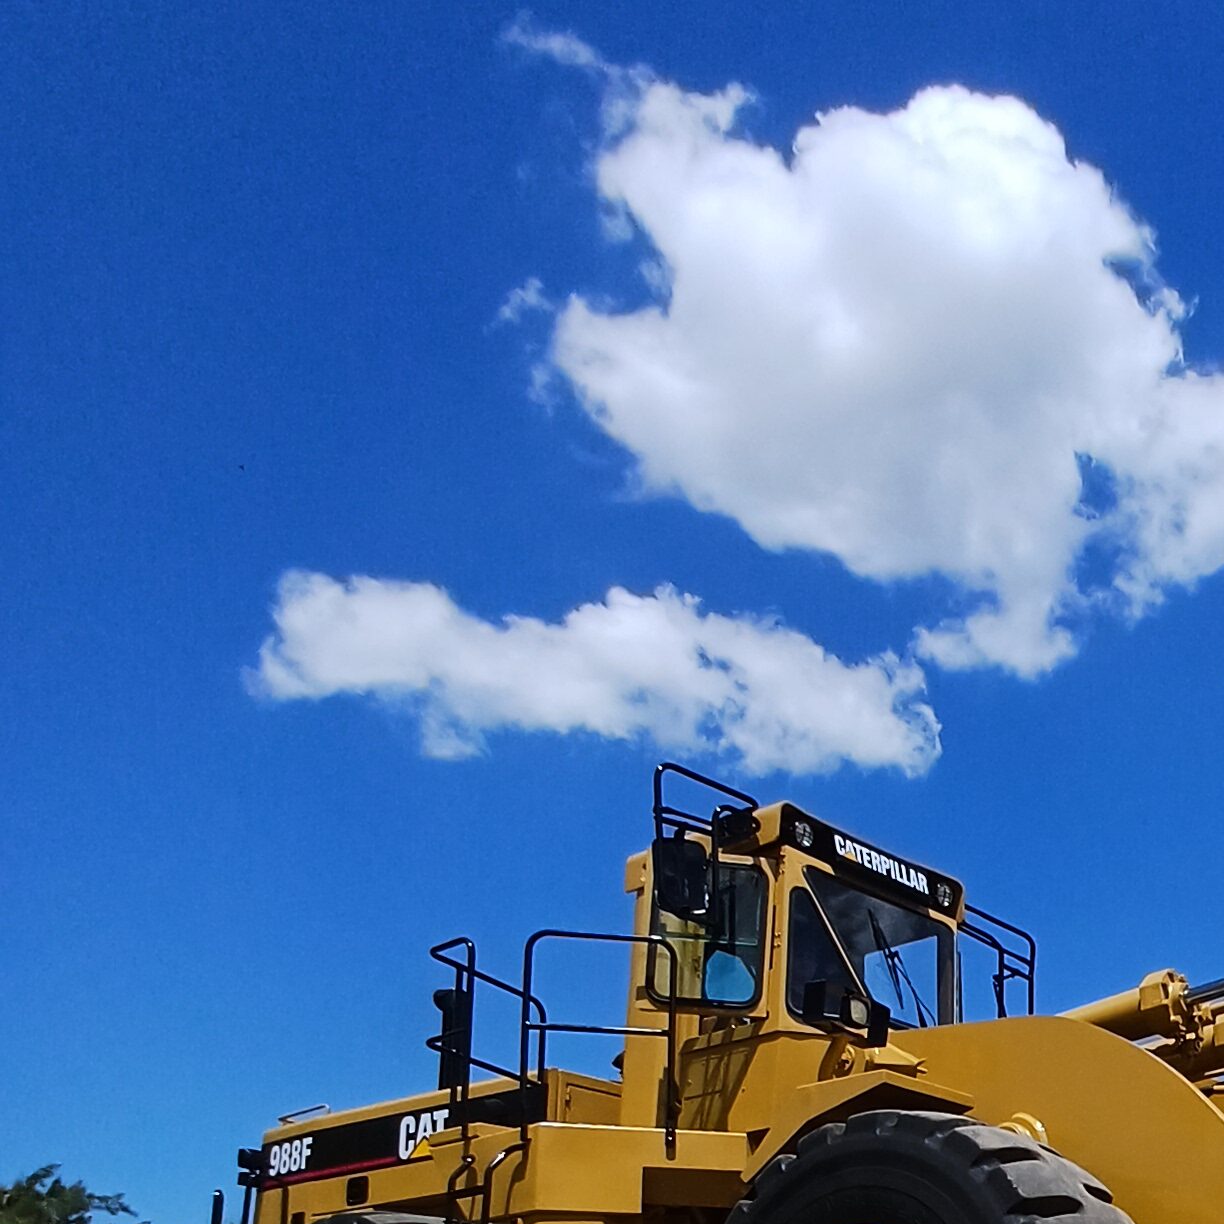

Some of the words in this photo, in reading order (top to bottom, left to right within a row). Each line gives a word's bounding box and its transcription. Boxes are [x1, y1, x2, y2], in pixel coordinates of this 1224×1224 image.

[833, 834, 930, 895] CATERPILLAR
[268, 1137, 313, 1177] 988F
[398, 1109, 450, 1160] CAT
